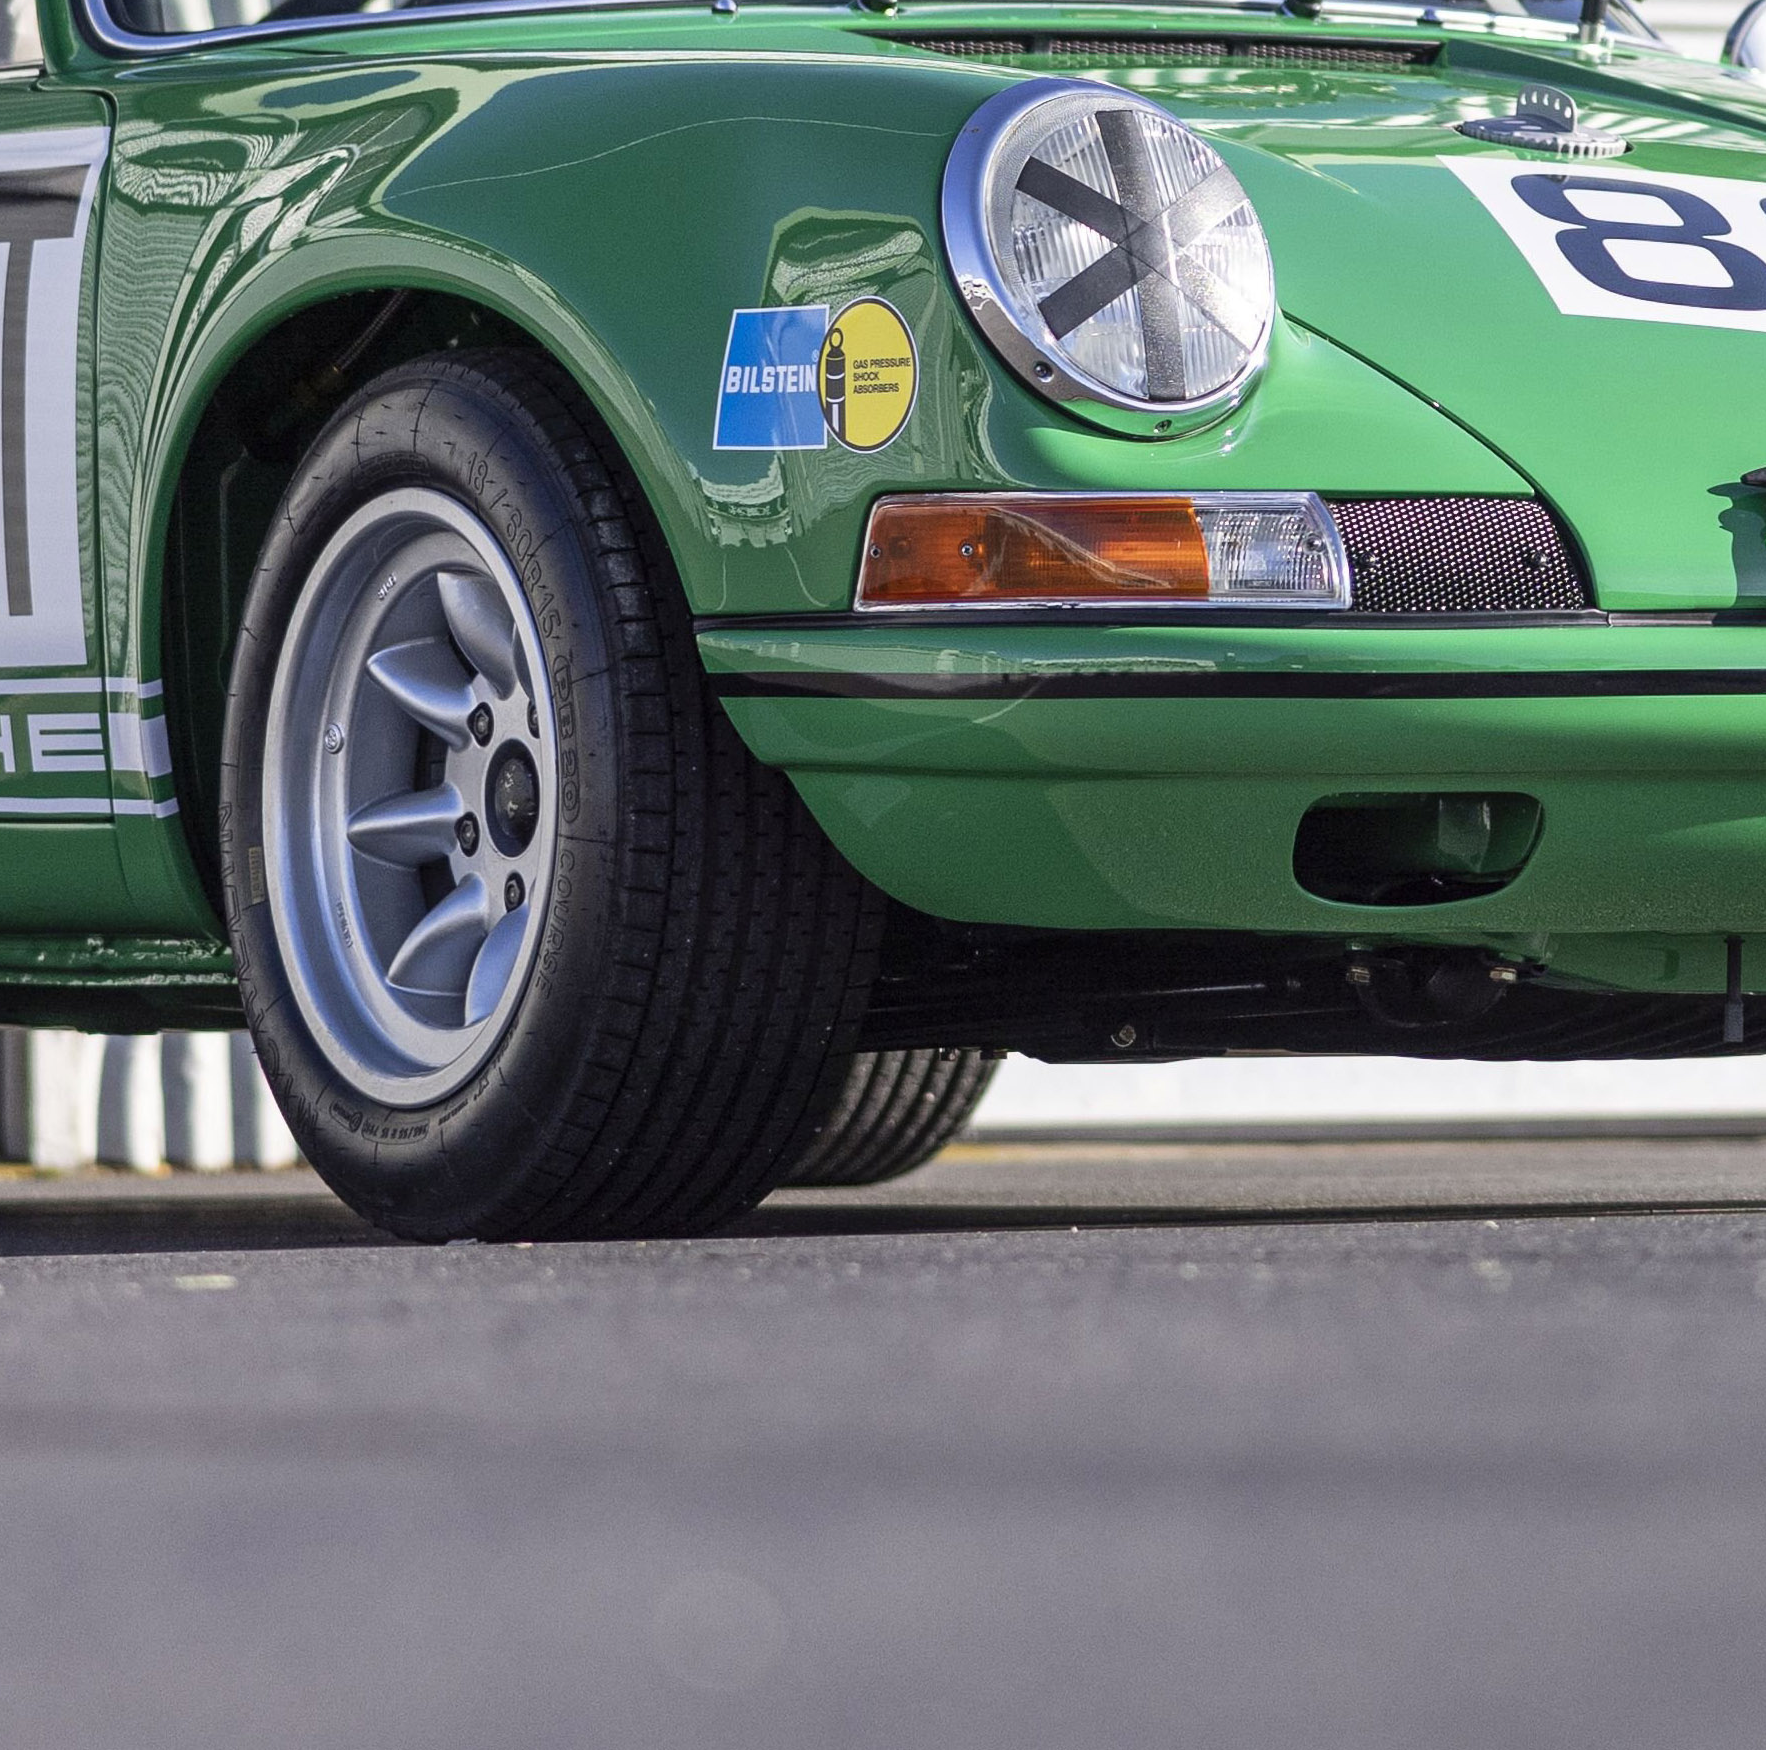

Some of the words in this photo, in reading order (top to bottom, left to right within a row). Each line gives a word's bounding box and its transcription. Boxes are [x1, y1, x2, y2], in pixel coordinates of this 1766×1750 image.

[852, 358, 869, 370] GAS
[869, 356, 912, 369] PRESSURE
[725, 364, 817, 394] BILSTEIN
[852, 371, 880, 382] SHOCK
[852, 382, 900, 394] ABSORBERS
